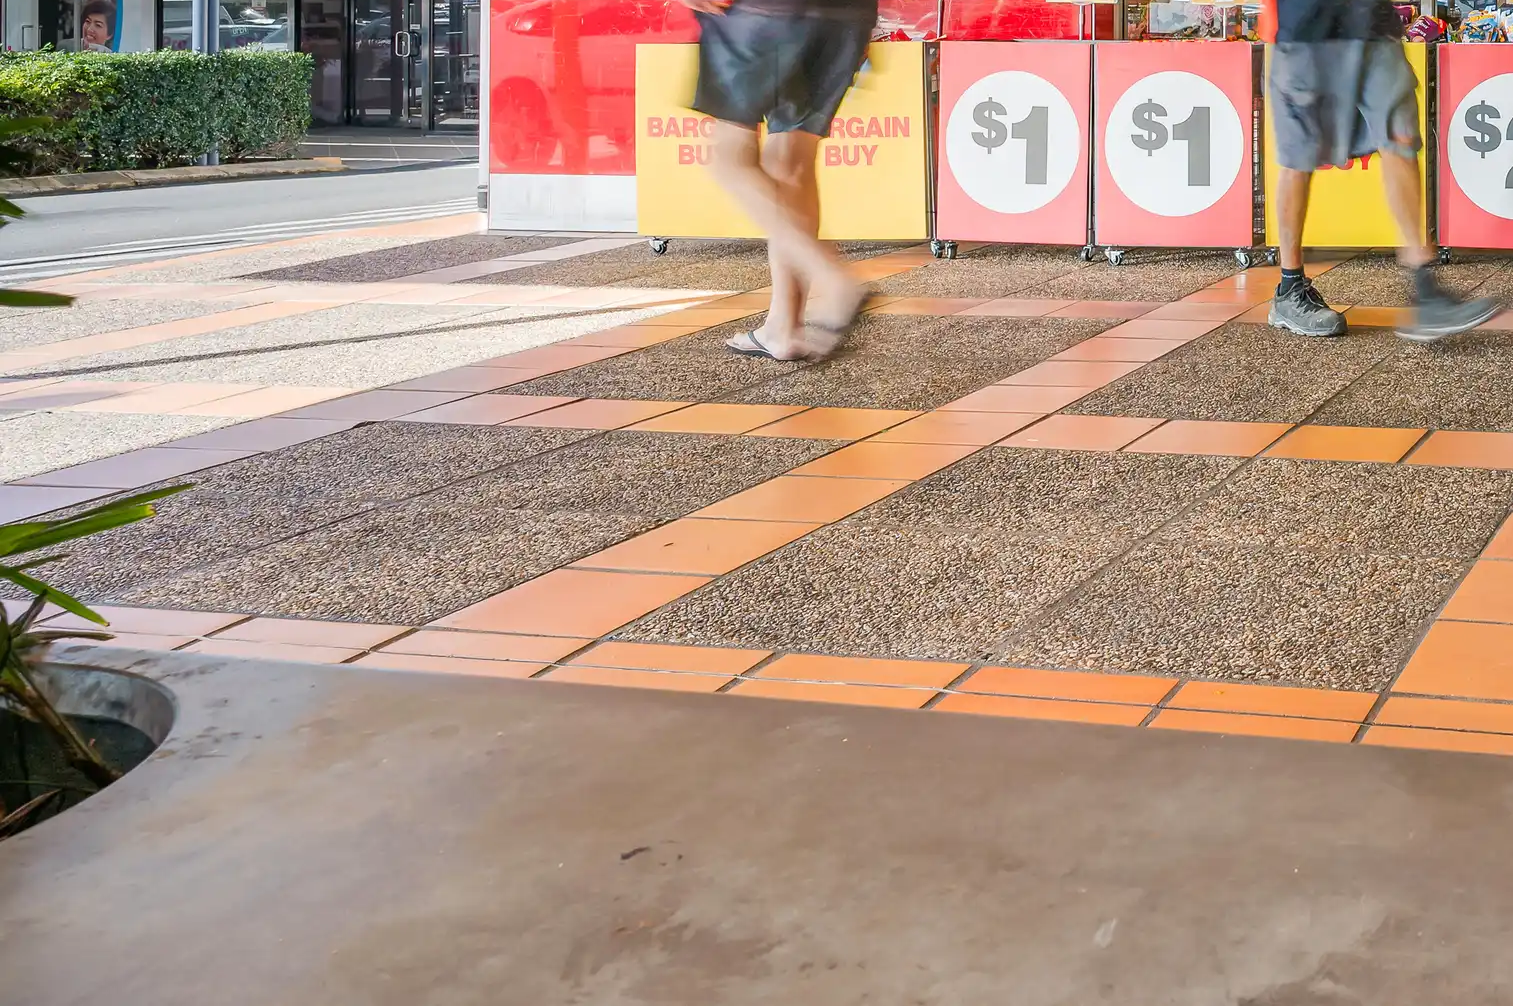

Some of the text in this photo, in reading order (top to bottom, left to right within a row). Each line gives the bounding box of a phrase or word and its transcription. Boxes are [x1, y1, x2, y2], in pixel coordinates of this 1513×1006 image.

[830, 116, 911, 139] RGAIN
[971, 97, 1049, 185] $1
[1131, 98, 1211, 187] $1
[678, 144, 713, 166] BU
[825, 144, 878, 167] BUY
